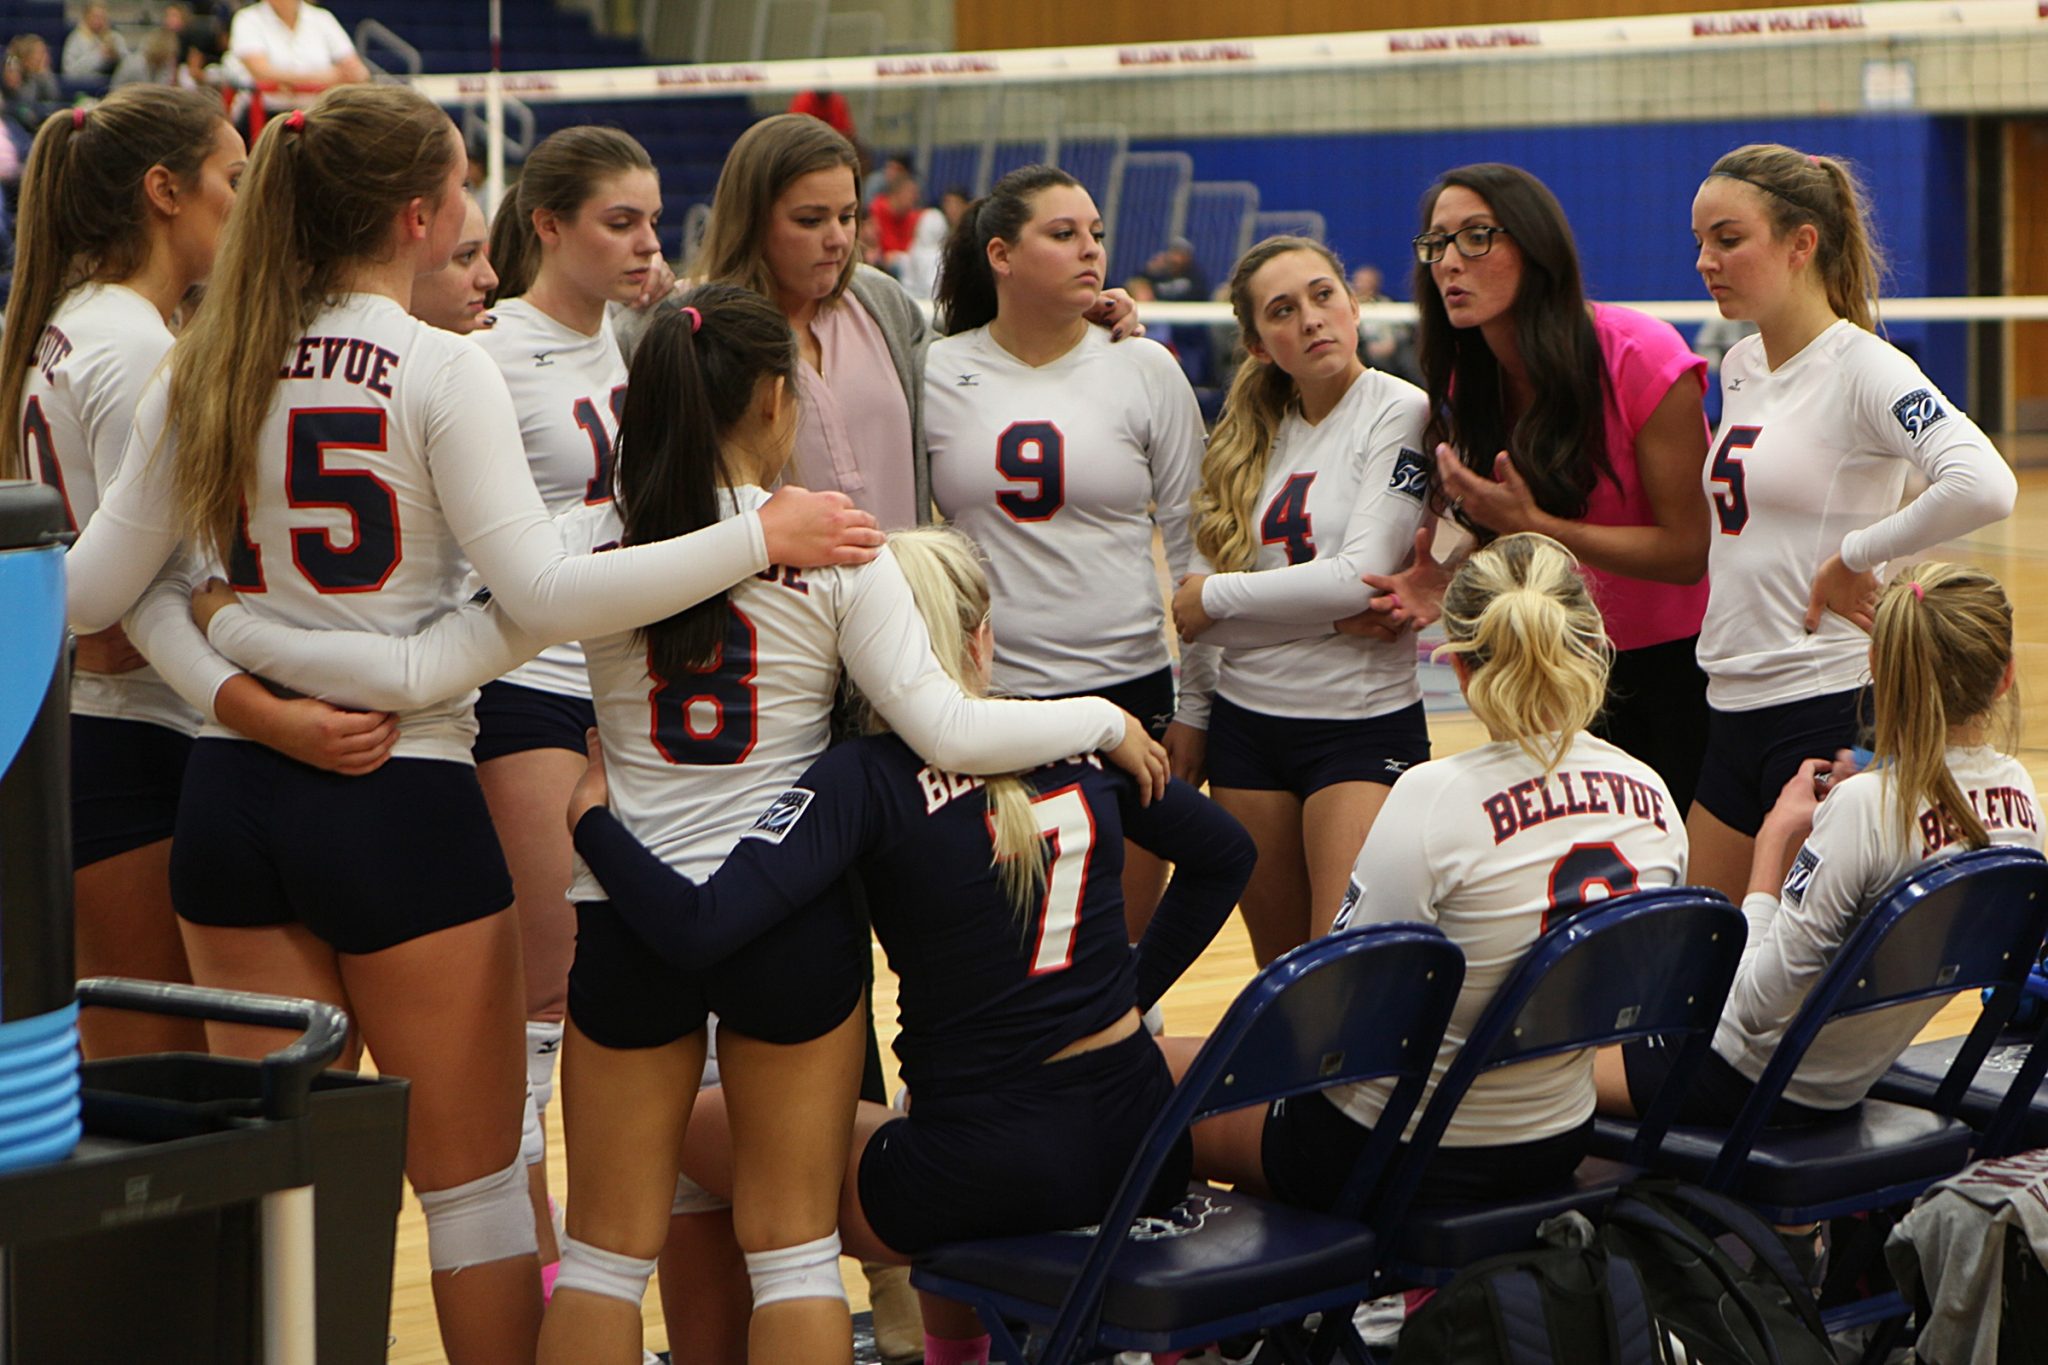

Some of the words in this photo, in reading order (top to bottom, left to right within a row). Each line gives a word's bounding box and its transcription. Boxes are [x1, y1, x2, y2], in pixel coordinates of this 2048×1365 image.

[995, 420, 1065, 523] 9
[1260, 471, 1318, 567] 4
[1710, 425, 1764, 536] 5
[646, 598, 758, 766] 8
[1482, 771, 1669, 846] BELLEVUE
[983, 783, 1097, 977] 7
